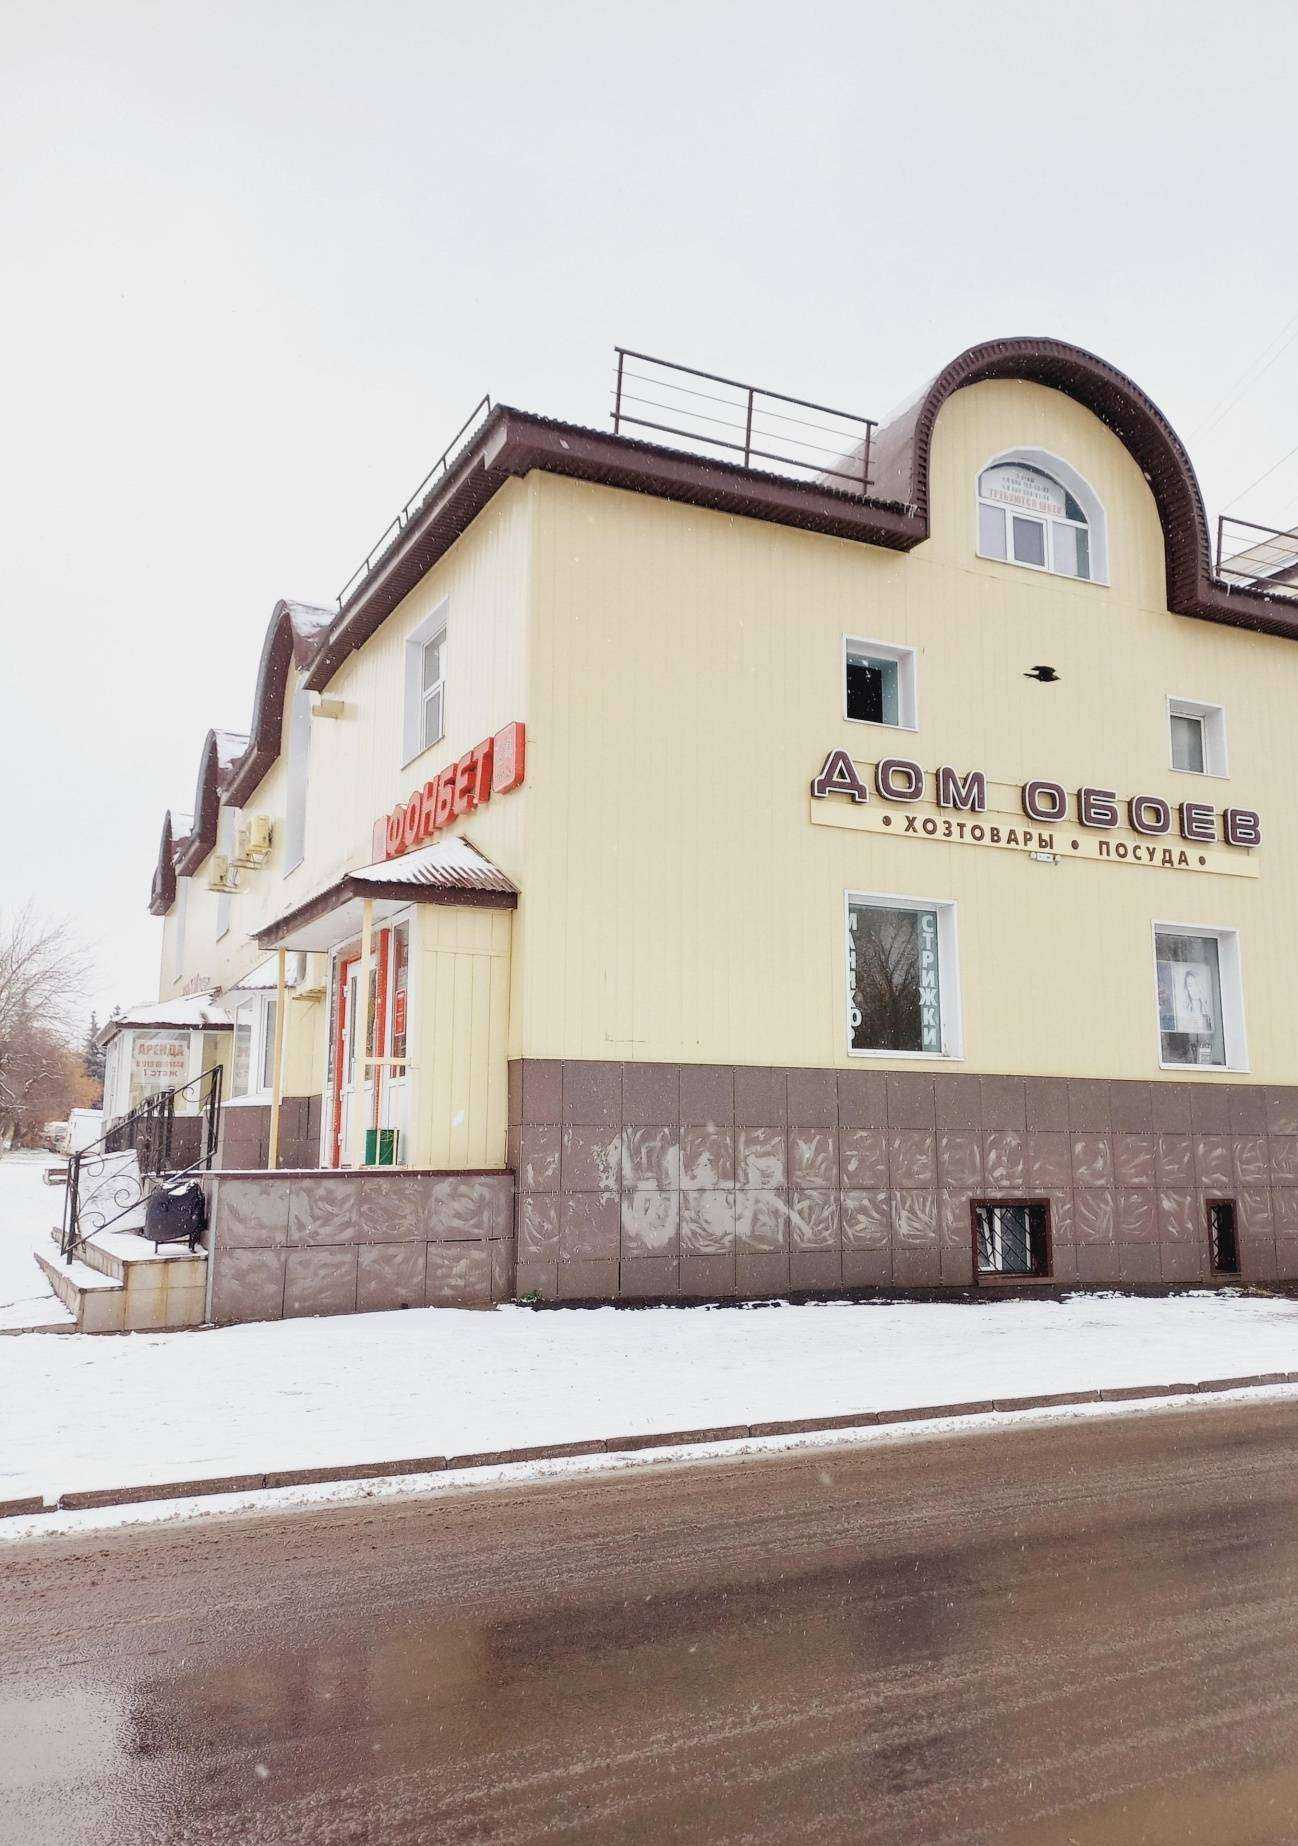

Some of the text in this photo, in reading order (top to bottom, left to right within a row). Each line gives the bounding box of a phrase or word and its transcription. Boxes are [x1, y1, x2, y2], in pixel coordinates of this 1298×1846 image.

[811, 748, 1263, 848] ДОМ ОБОЕВ
[904, 815, 1189, 867] ХОЗТОВАРЫ ПОСУДА
[919, 915, 938, 1046] СТРИЖКИ
